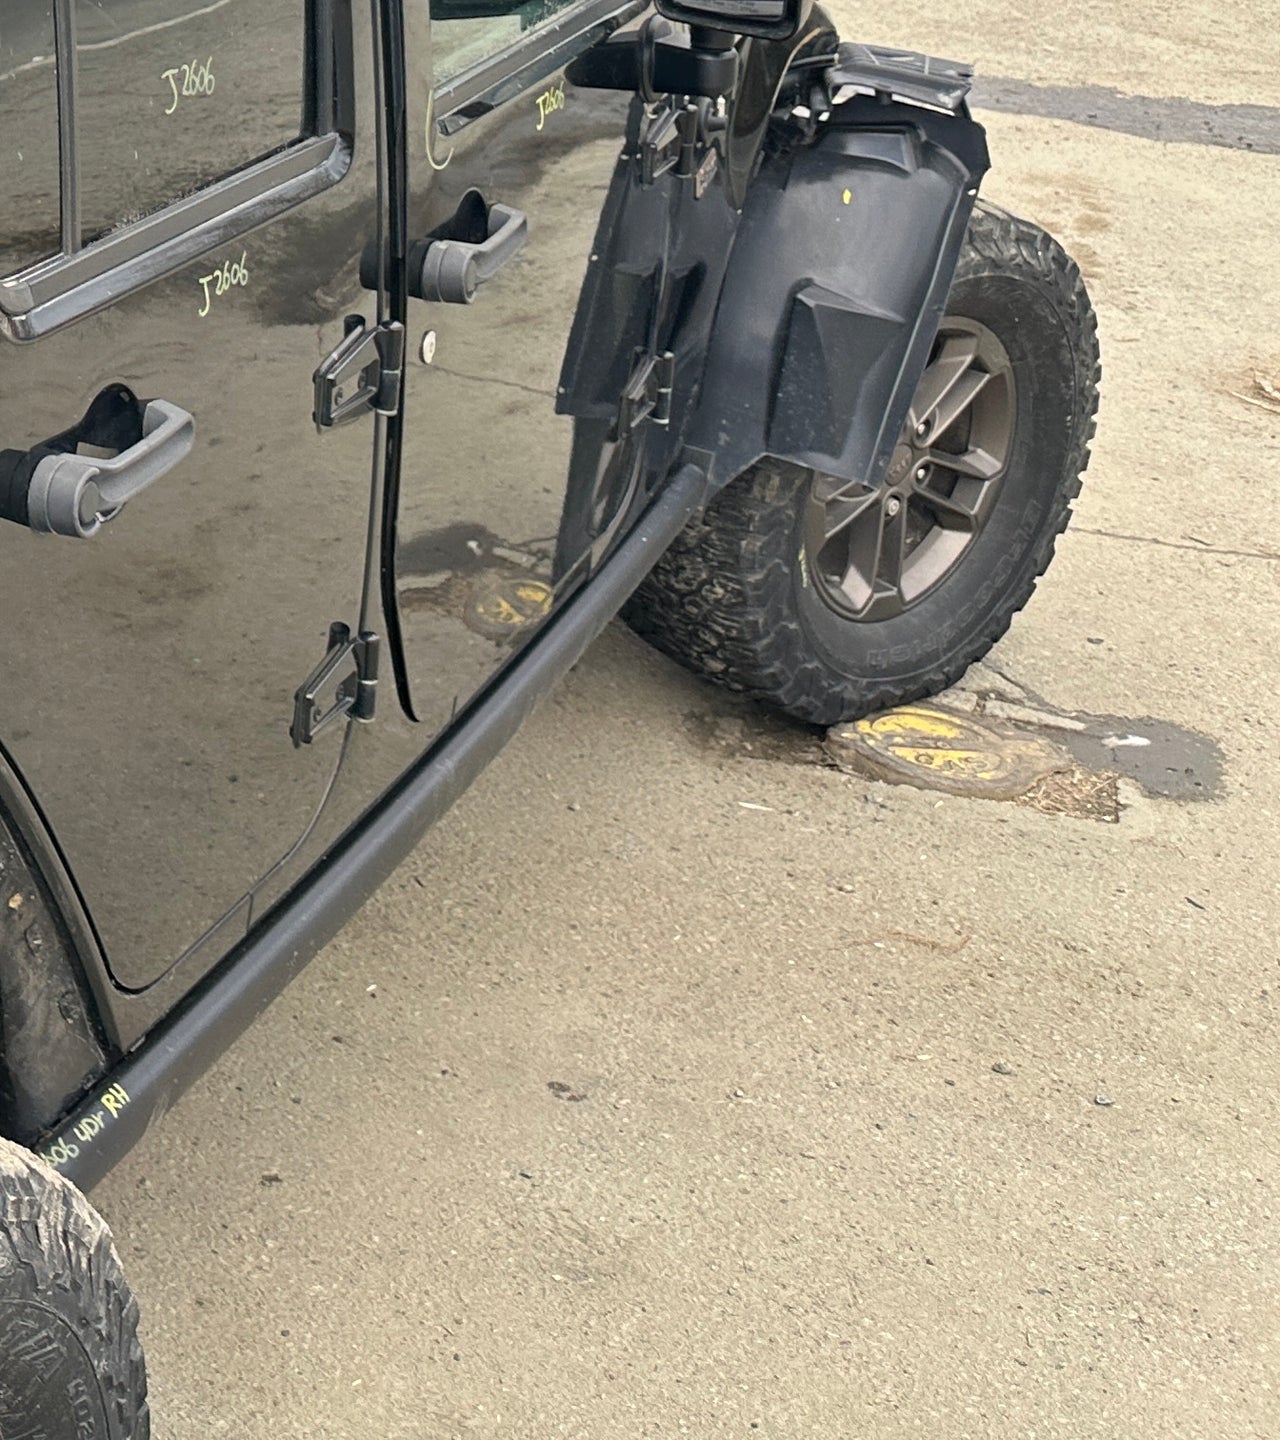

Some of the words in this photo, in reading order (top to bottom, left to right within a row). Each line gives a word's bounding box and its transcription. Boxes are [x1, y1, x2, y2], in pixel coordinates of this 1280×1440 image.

[161, 56, 215, 114] J2606
[535, 81, 565, 131] J2606
[198, 250, 249, 317] J2606
[101, 1083, 131, 1119] RH
